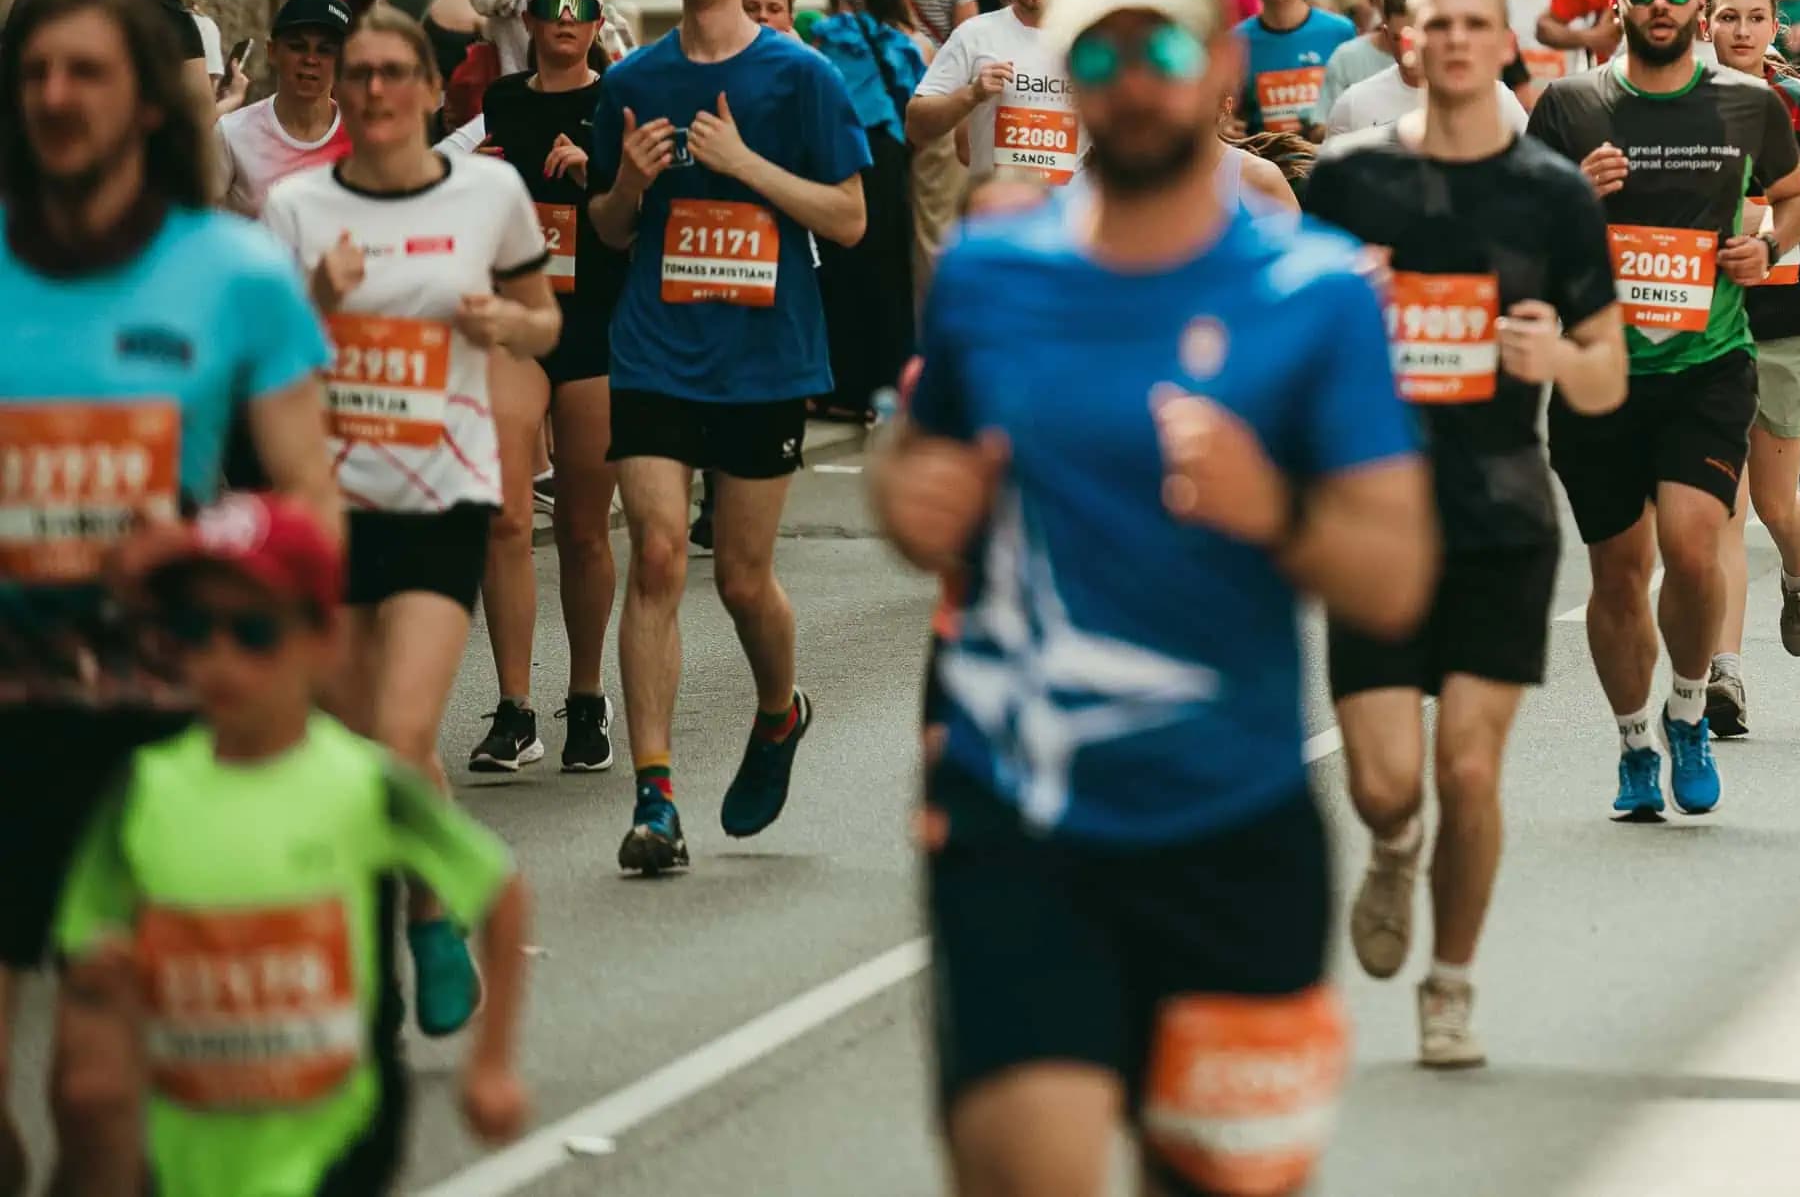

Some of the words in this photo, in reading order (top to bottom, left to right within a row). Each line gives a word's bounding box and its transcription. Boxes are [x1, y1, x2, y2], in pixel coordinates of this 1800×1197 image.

[1005, 126, 1068, 149] 22080
[1629, 146, 1661, 156] great
[1664, 144, 1708, 156] people
[1012, 153, 1056, 165] SANDIS
[1630, 160, 1661, 170] great
[1664, 160, 1721, 172] company
[678, 226, 760, 256] 21171
[664, 263, 706, 275] TOMASS
[1620, 251, 1701, 281] 20031
[1631, 287, 1688, 303] DENISS
